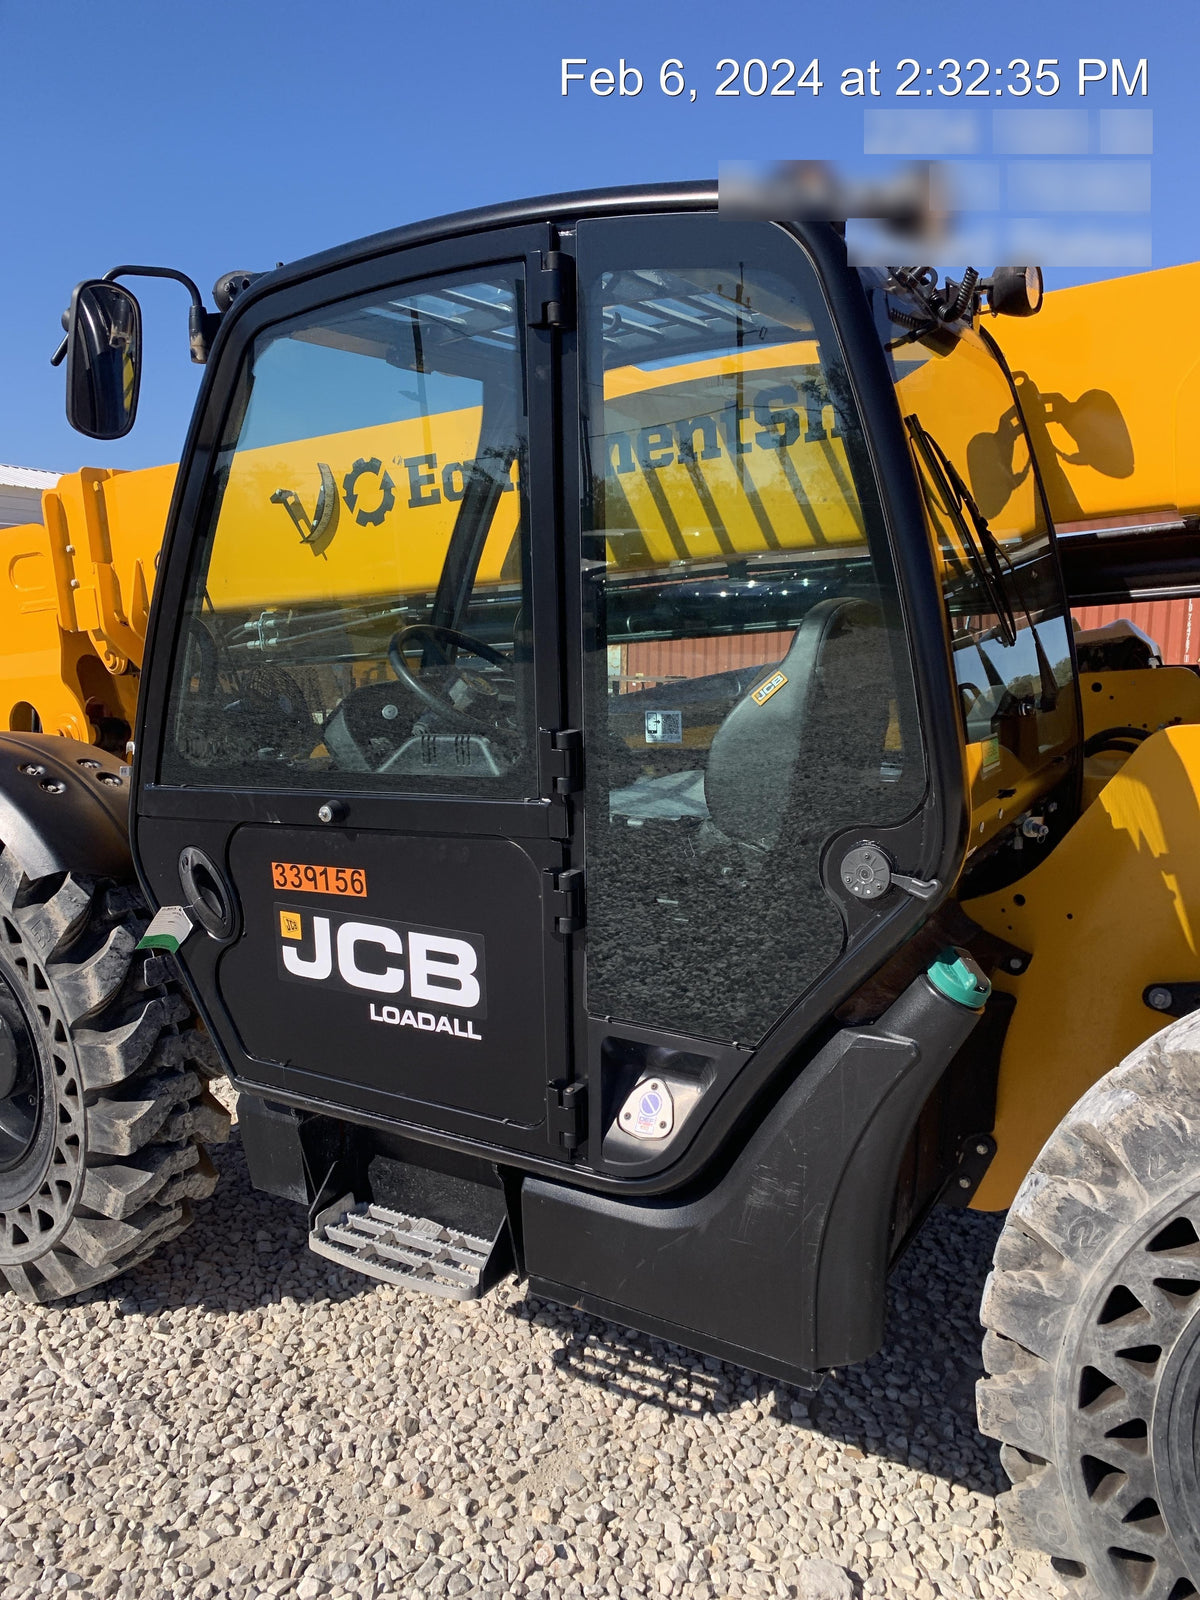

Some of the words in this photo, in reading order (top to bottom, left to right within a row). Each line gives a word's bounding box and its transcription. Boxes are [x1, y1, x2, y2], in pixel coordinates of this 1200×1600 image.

[757, 675, 784, 700] JCB
[274, 863, 366, 895] 339156
[281, 915, 481, 1008] JCB
[369, 1003, 482, 1040] LOADALL
